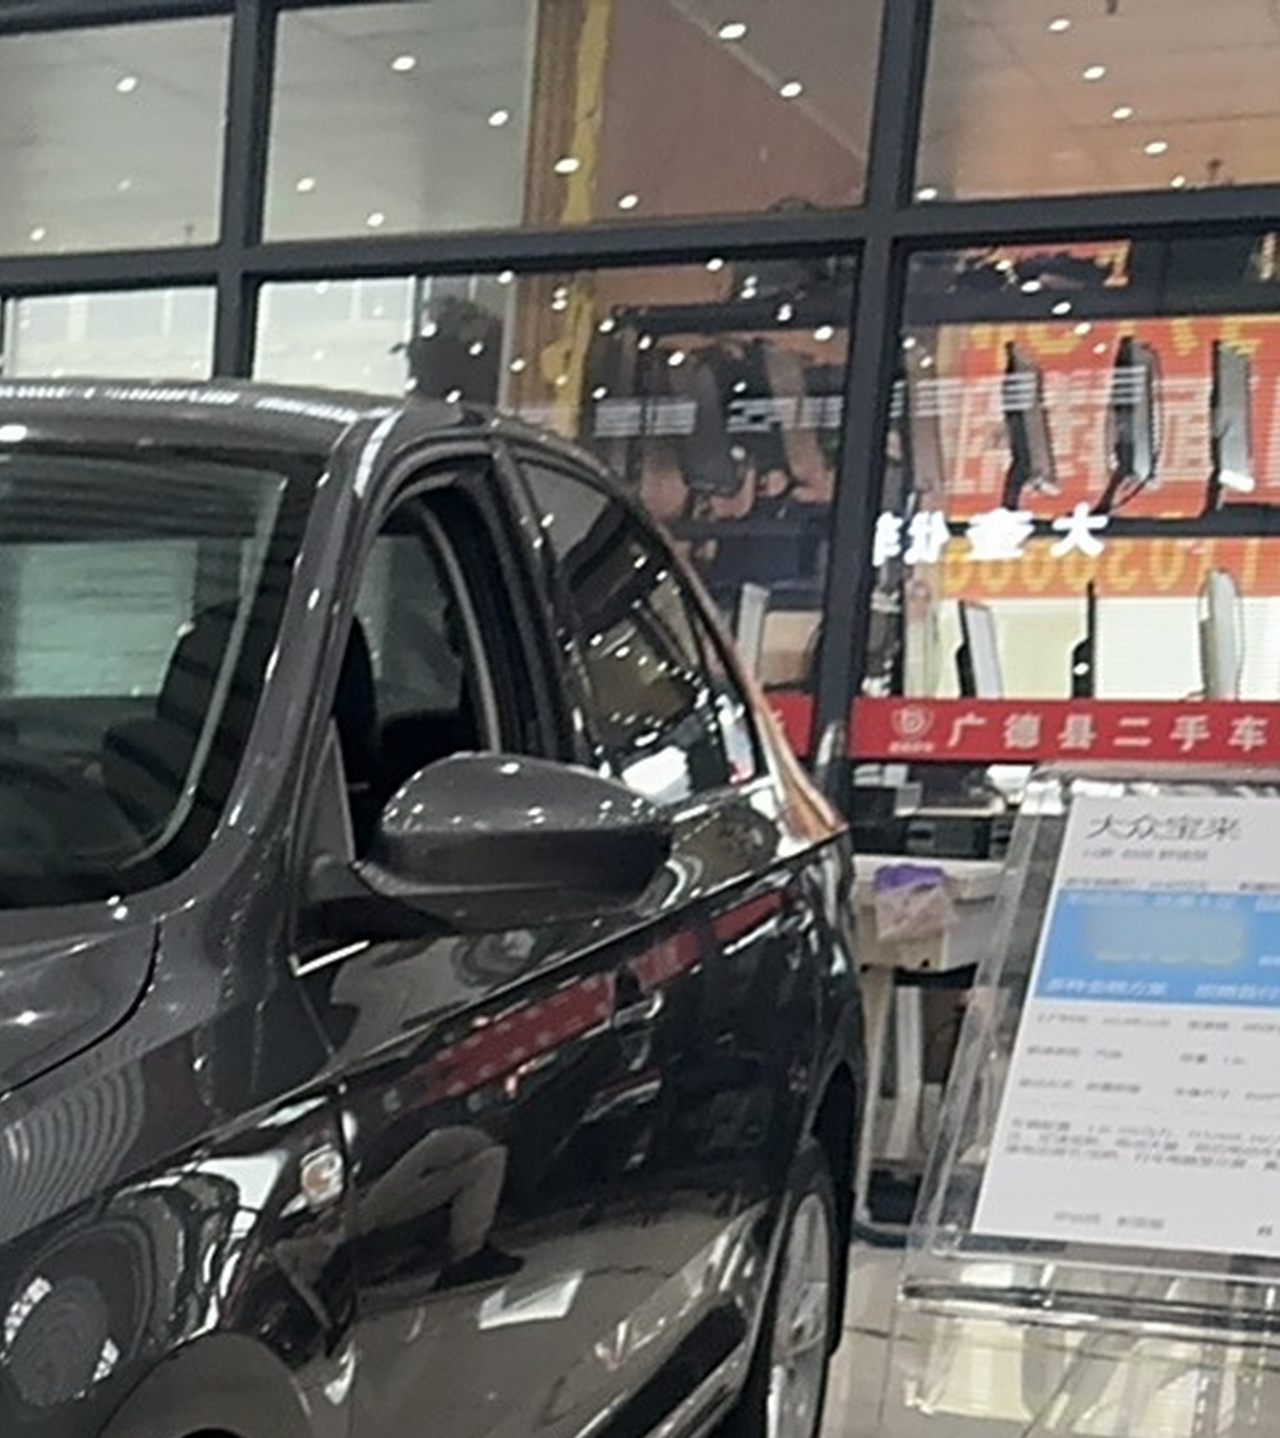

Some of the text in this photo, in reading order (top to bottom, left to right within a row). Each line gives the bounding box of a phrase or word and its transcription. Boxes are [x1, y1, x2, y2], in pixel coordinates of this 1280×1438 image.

[948, 713, 1268, 751] 广德县二手车
[1086, 813, 1242, 842] 大众宝来
